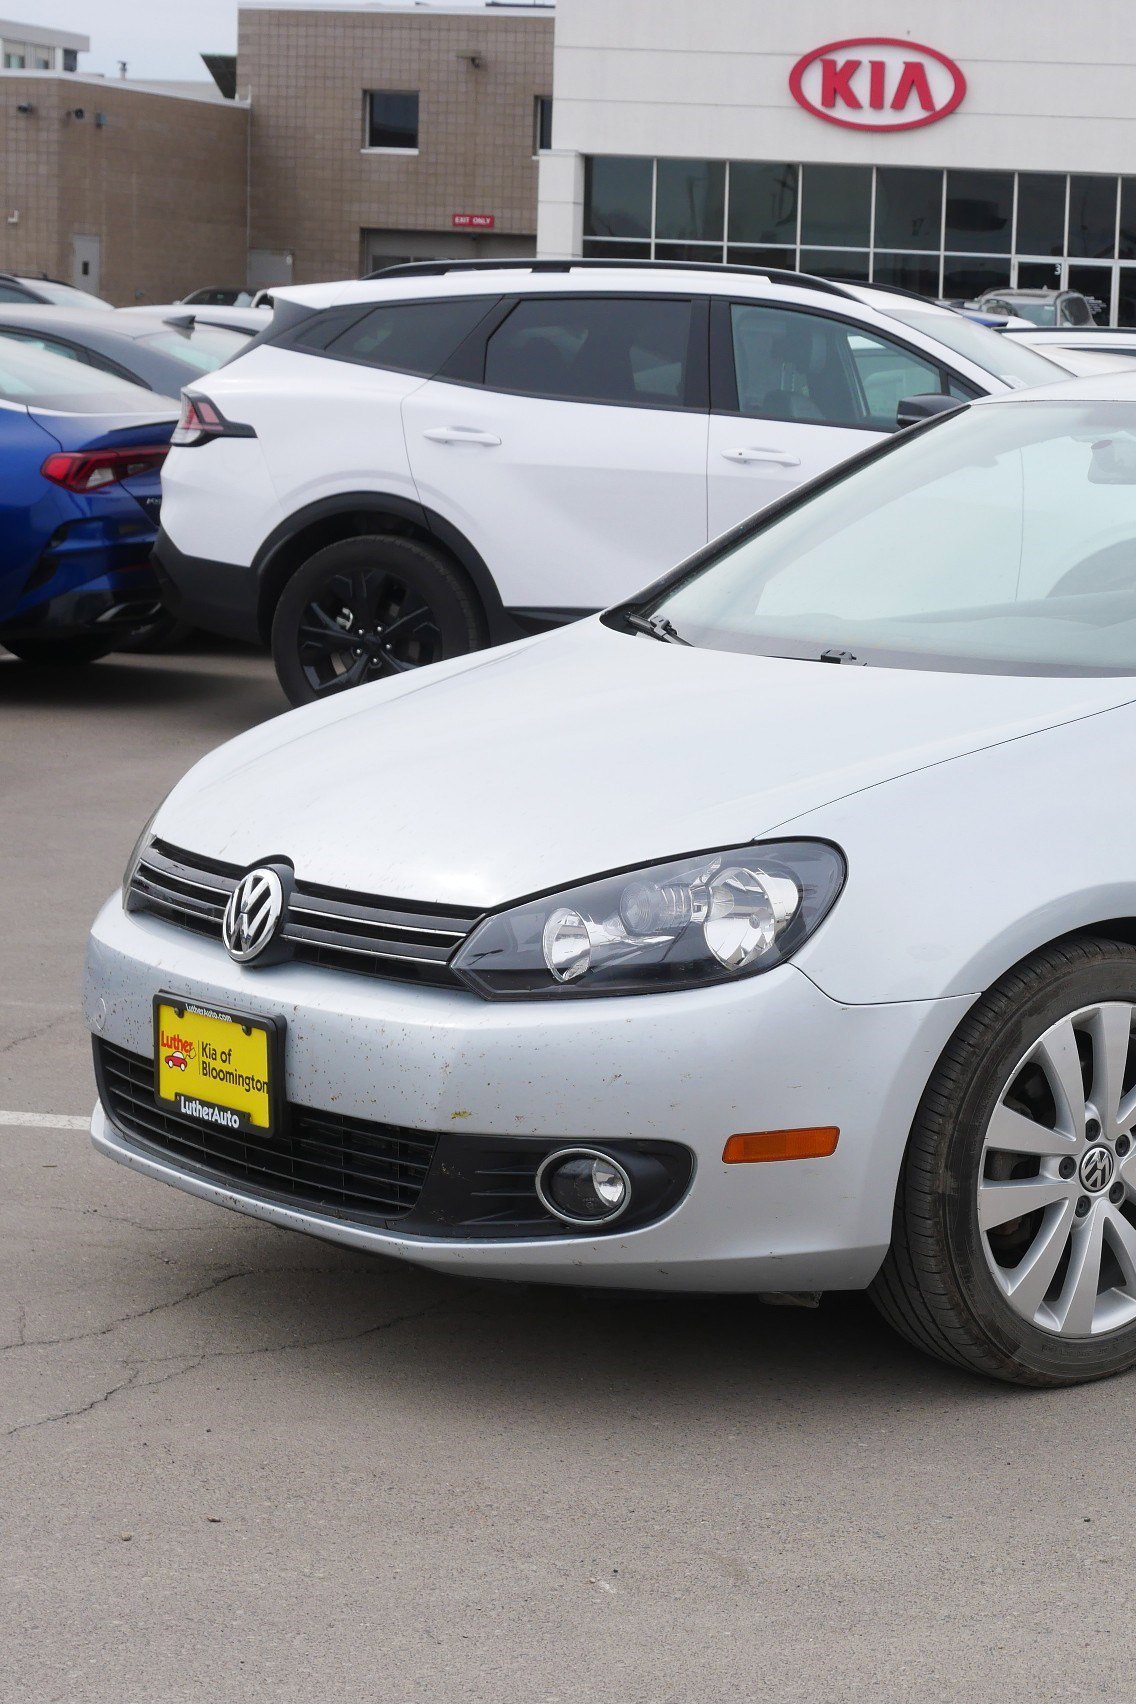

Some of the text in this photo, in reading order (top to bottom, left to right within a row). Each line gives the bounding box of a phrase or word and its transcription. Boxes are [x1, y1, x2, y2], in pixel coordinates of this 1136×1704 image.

[819, 58, 936, 112] KIA
[160, 1030, 193, 1054] Luther
[201, 1041, 233, 1065] Kia of
[201, 1060, 269, 1095] Bloomington
[180, 1096, 240, 1129] LutherAuto
